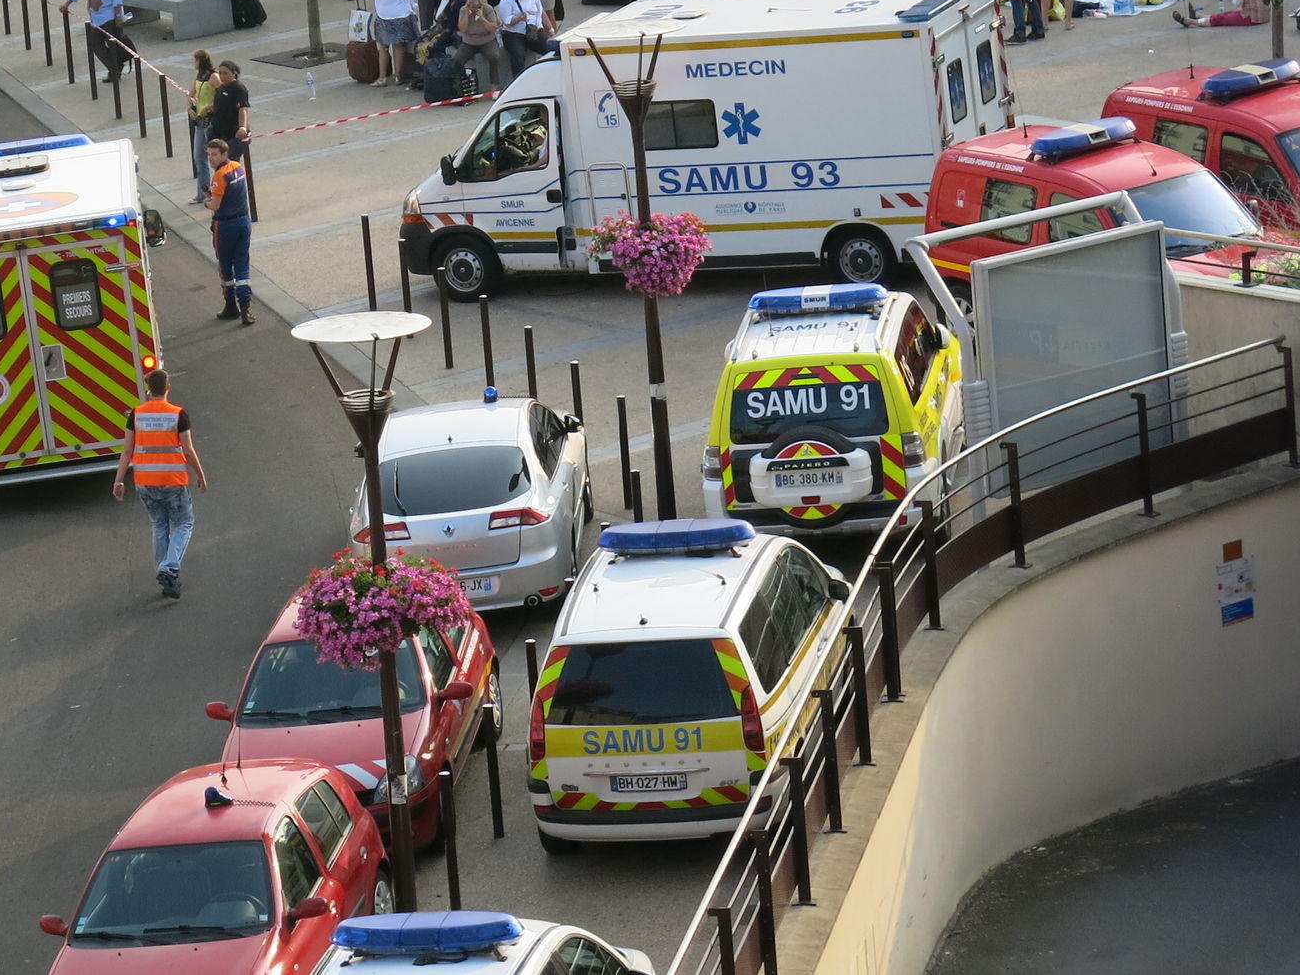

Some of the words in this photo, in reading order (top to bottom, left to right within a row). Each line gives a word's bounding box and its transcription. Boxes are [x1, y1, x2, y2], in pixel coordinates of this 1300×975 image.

[685, 59, 786, 79] MEDECIN
[604, 114, 617, 126] 15
[658, 164, 768, 194] SAMU
[790, 161, 841, 188] 93
[500, 199, 525, 209] SMUR
[495, 218, 536, 228] AVICENNE
[62, 290, 92, 305] PREMIERS
[804, 296, 827, 304] SMUR
[65, 304, 93, 319] SECOURS
[770, 322, 827, 334] SAMU
[837, 320, 859, 332] 91
[746, 387, 828, 419] SAMU
[839, 383, 871, 412] 91
[784, 460, 831, 470] PAJERO
[583, 728, 665, 755] SAMU
[674, 726, 703, 751] 91
[587, 758, 703, 769] PEUGEOT
[618, 775, 678, 790] BH-027-HW
